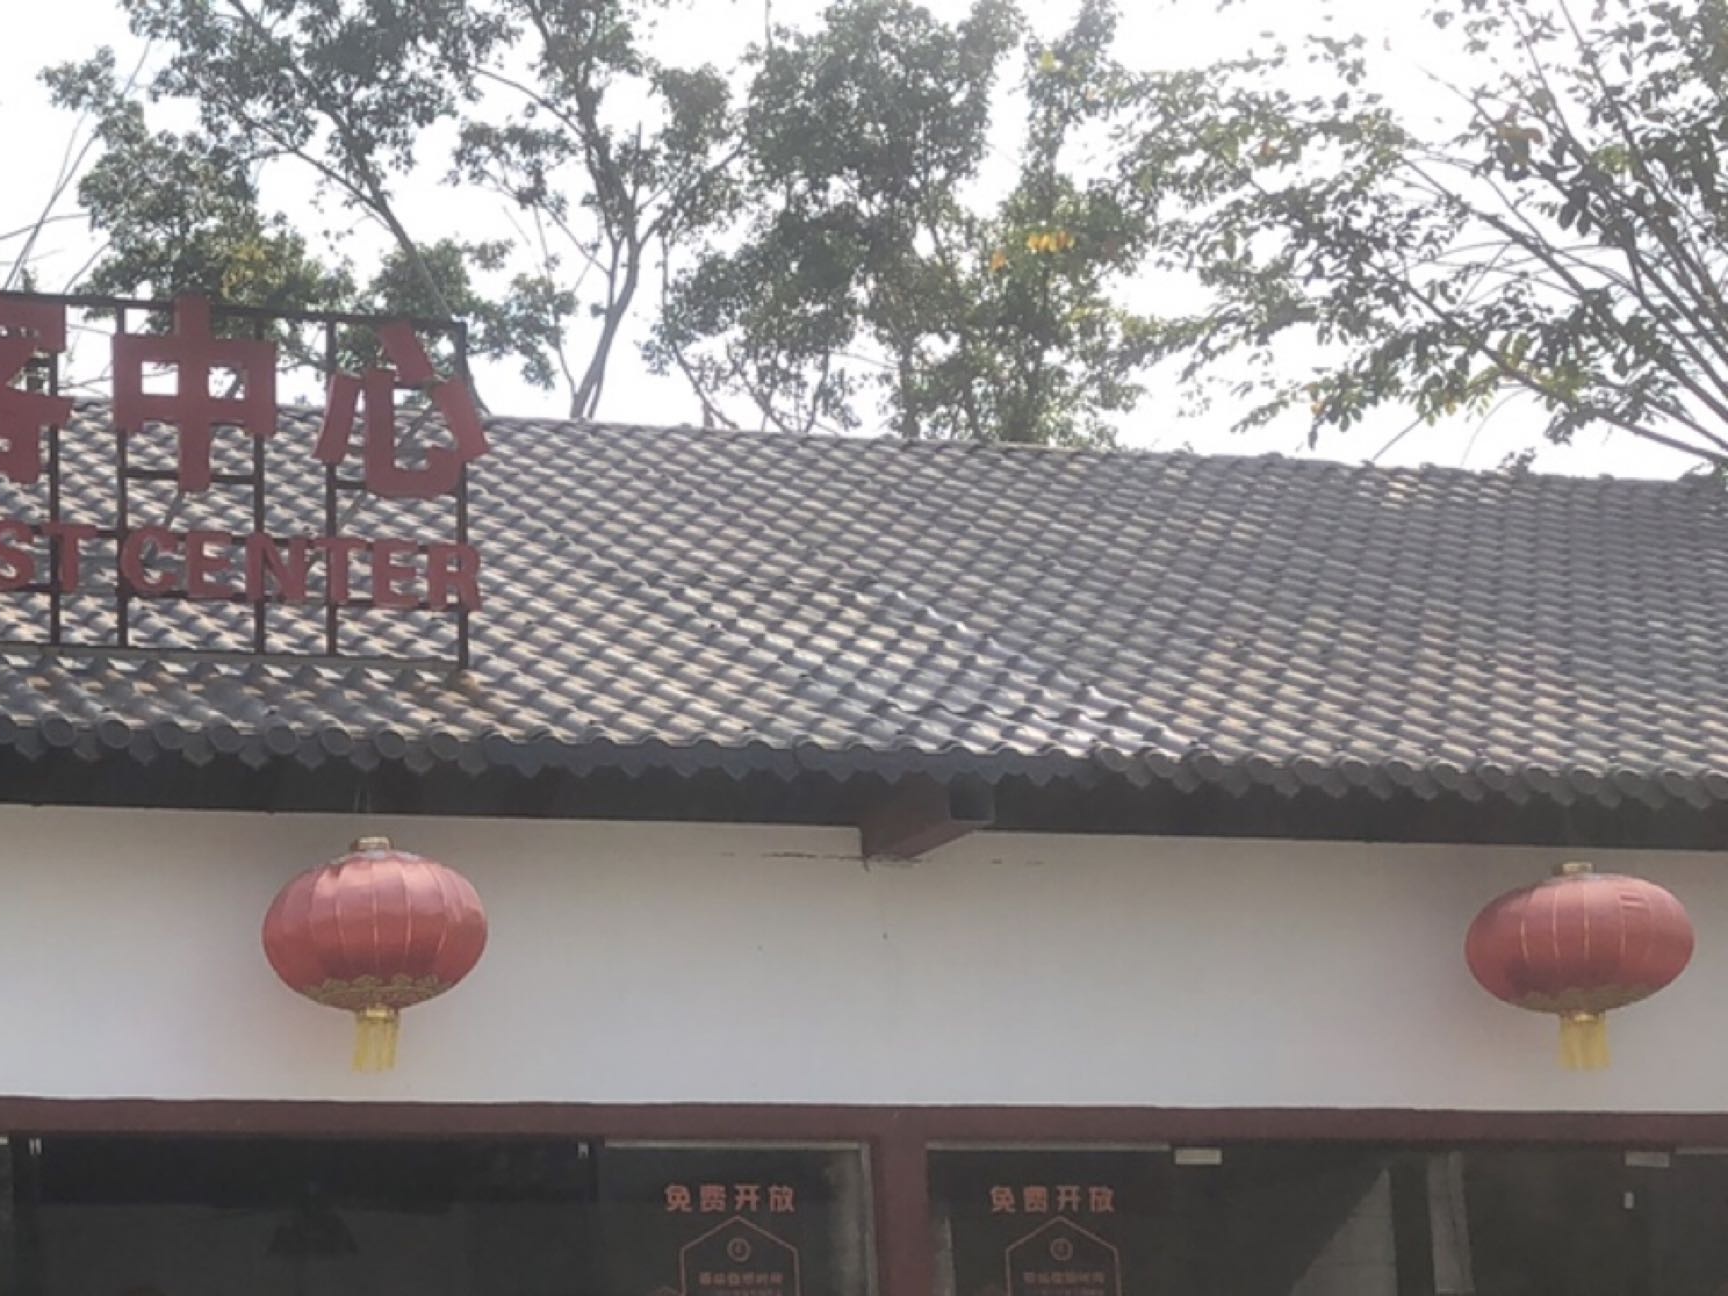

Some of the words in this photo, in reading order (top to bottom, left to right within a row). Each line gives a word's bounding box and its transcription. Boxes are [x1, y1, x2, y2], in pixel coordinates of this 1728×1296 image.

[119, 524, 482, 612] CENTER
[664, 1183, 796, 1213] 免费开放
[989, 1184, 1116, 1214] 免费开放
